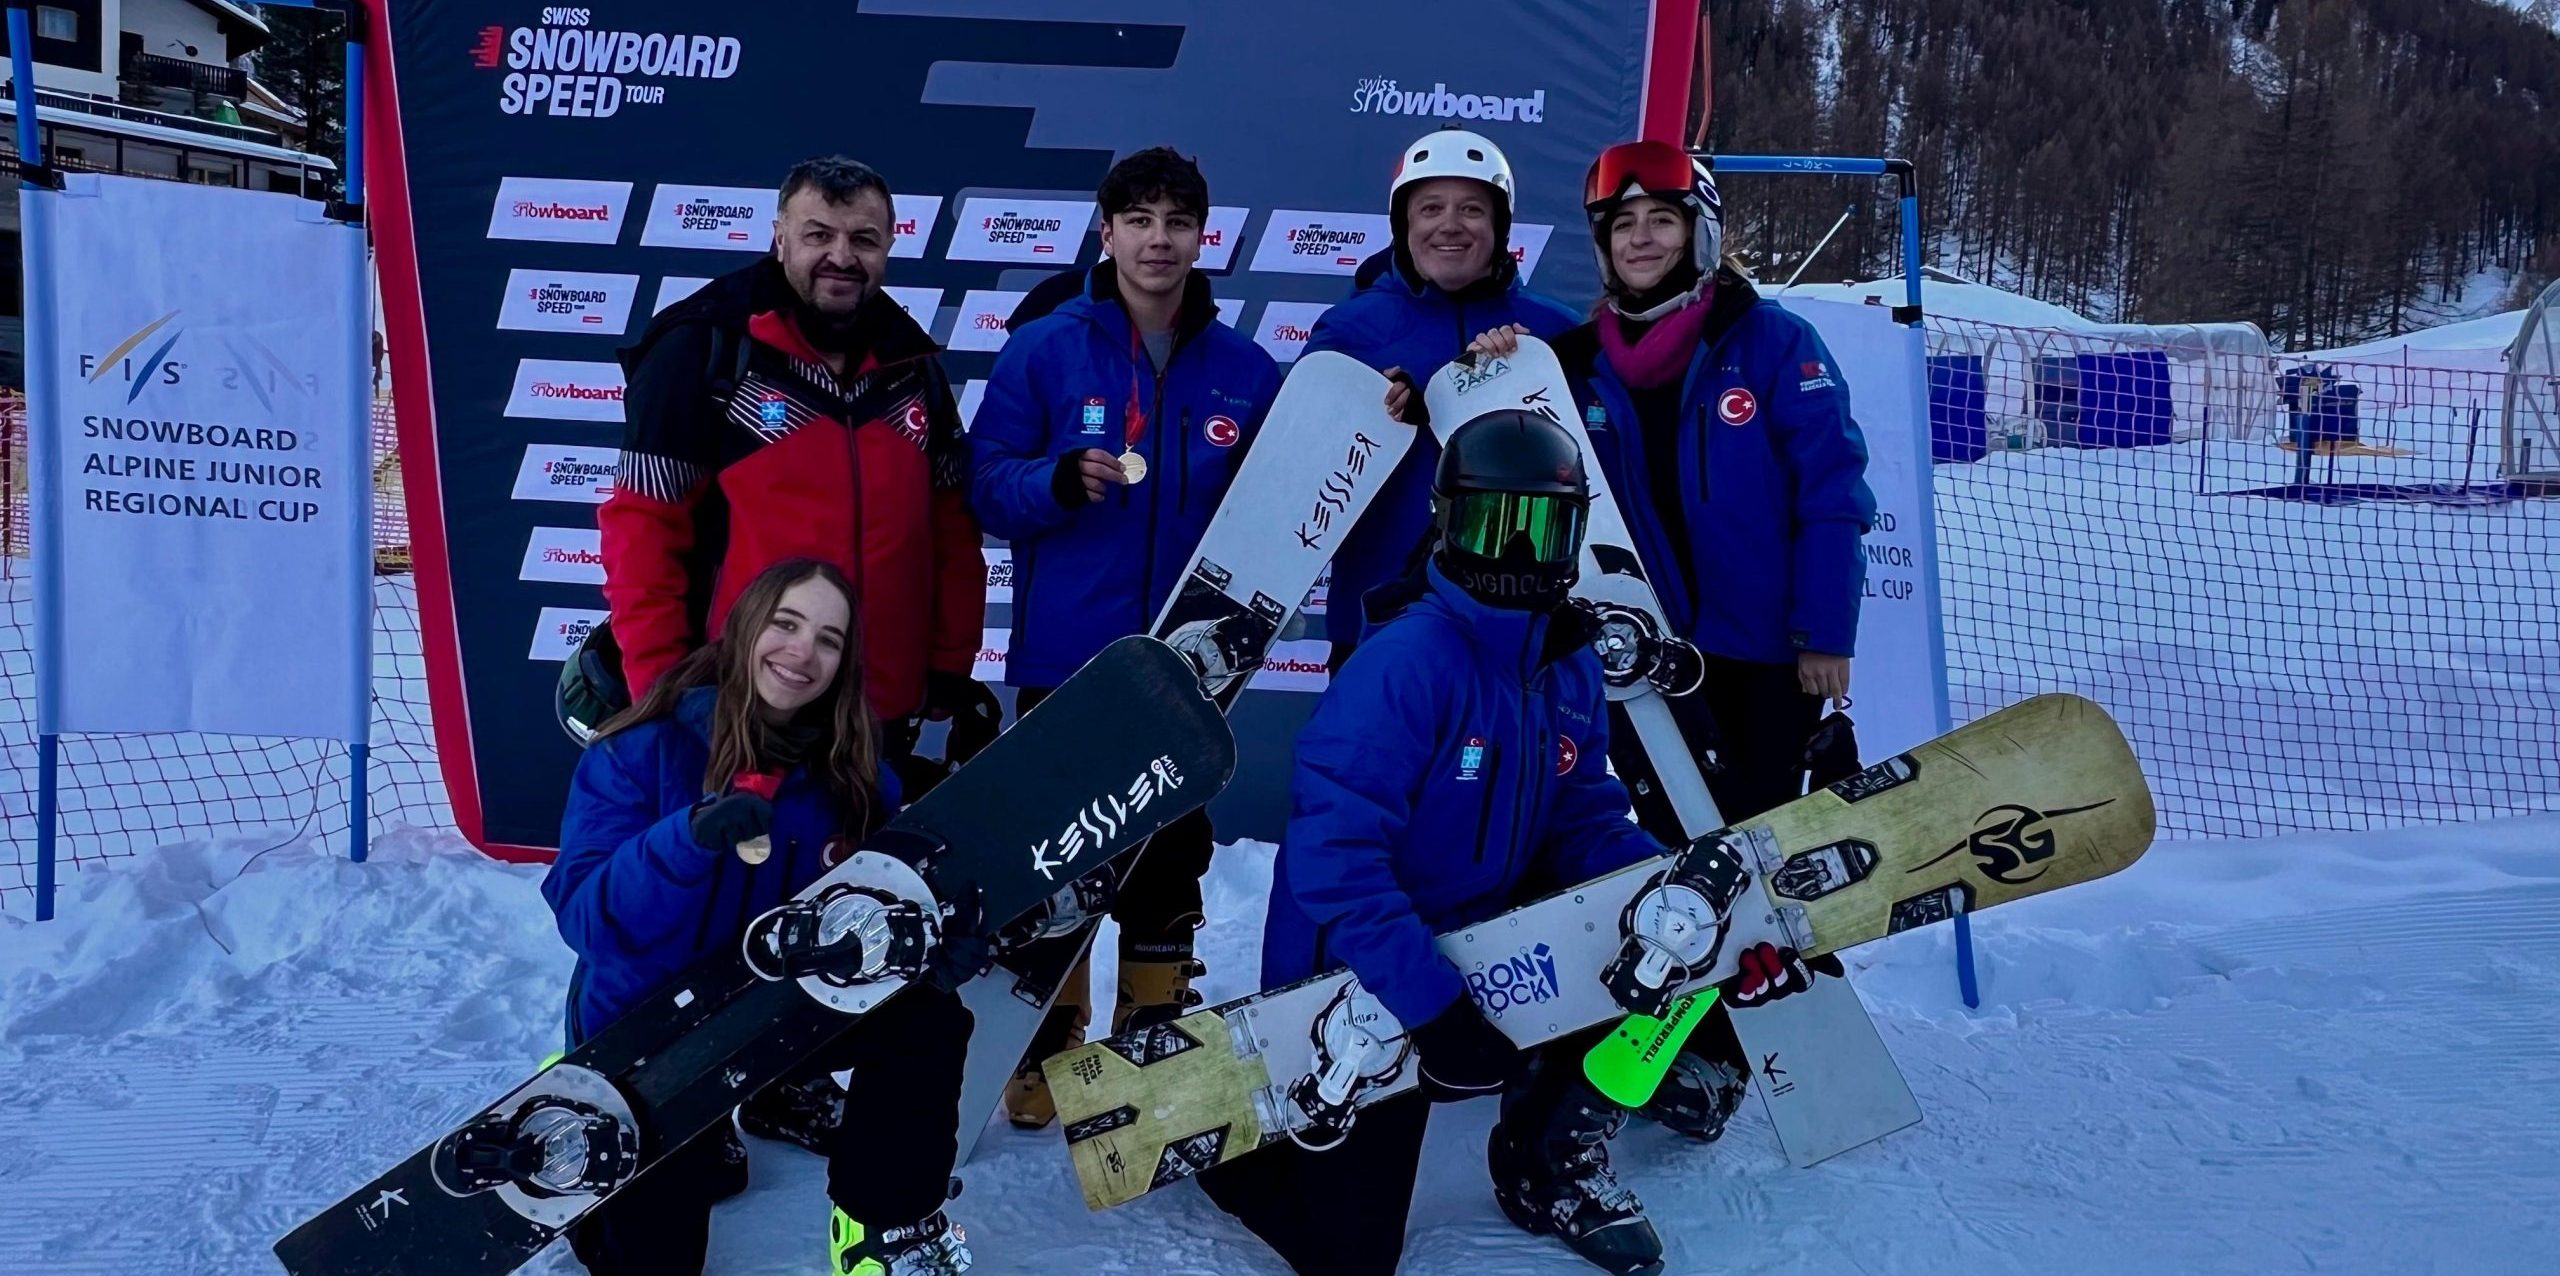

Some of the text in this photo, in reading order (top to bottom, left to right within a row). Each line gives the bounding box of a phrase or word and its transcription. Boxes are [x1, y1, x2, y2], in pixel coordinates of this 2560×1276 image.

[542, 7, 590, 26] SWISS
[507, 27, 740, 78] SNOWBOARD
[1358, 75, 1397, 92] swiss
[500, 73, 664, 118] SPEED TOUR
[684, 203, 753, 219] SNOWBOARD
[682, 217, 718, 230] SPEED
[992, 218, 1061, 231] SNOWBOARD
[989, 231, 1025, 243] SPEED
[1297, 230, 1366, 244] SNOWBOARD
[1293, 243, 1329, 255] SPEED
[538, 289, 606, 303] SNOWBOARD
[537, 301, 572, 314] SPEED
[83, 415, 297, 451] SNOWBOARD
[83, 453, 322, 489] ALPINE JUNIOR
[550, 474, 585, 486] SPEED
[1294, 432, 1381, 550] KESSLER
[85, 488, 320, 522] REGIONAL CUP
[1882, 579, 1914, 600] CUP
[1160, 755, 1184, 786] MILA
[1031, 759, 1179, 880] KESSLER
